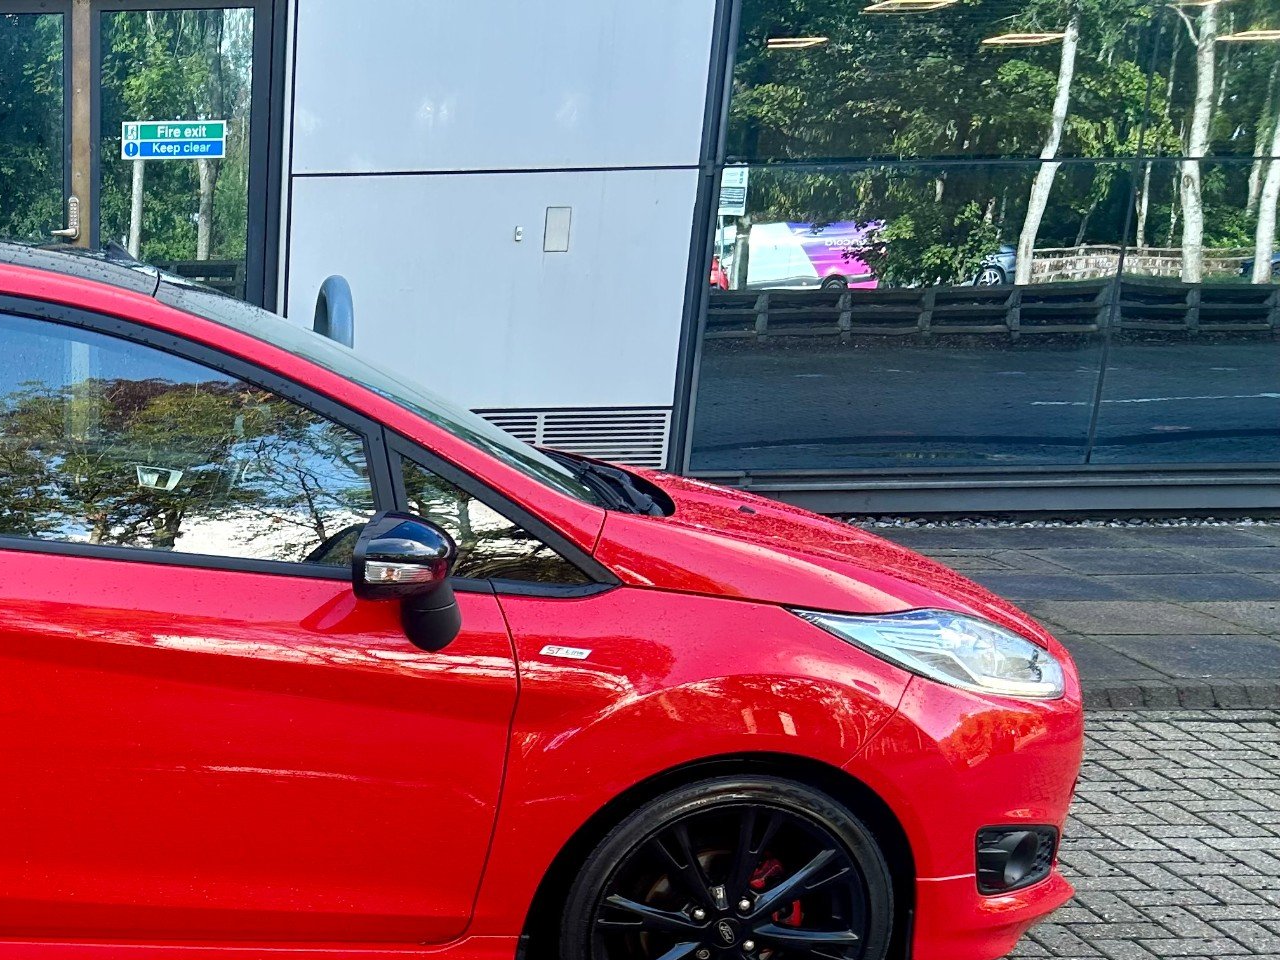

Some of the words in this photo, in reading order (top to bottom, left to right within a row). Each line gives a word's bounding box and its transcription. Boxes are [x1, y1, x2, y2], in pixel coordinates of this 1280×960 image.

[157, 126, 181, 138] Fire
[184, 125, 207, 138] exit
[152, 142, 180, 155] Keep
[183, 141, 211, 153] clear
